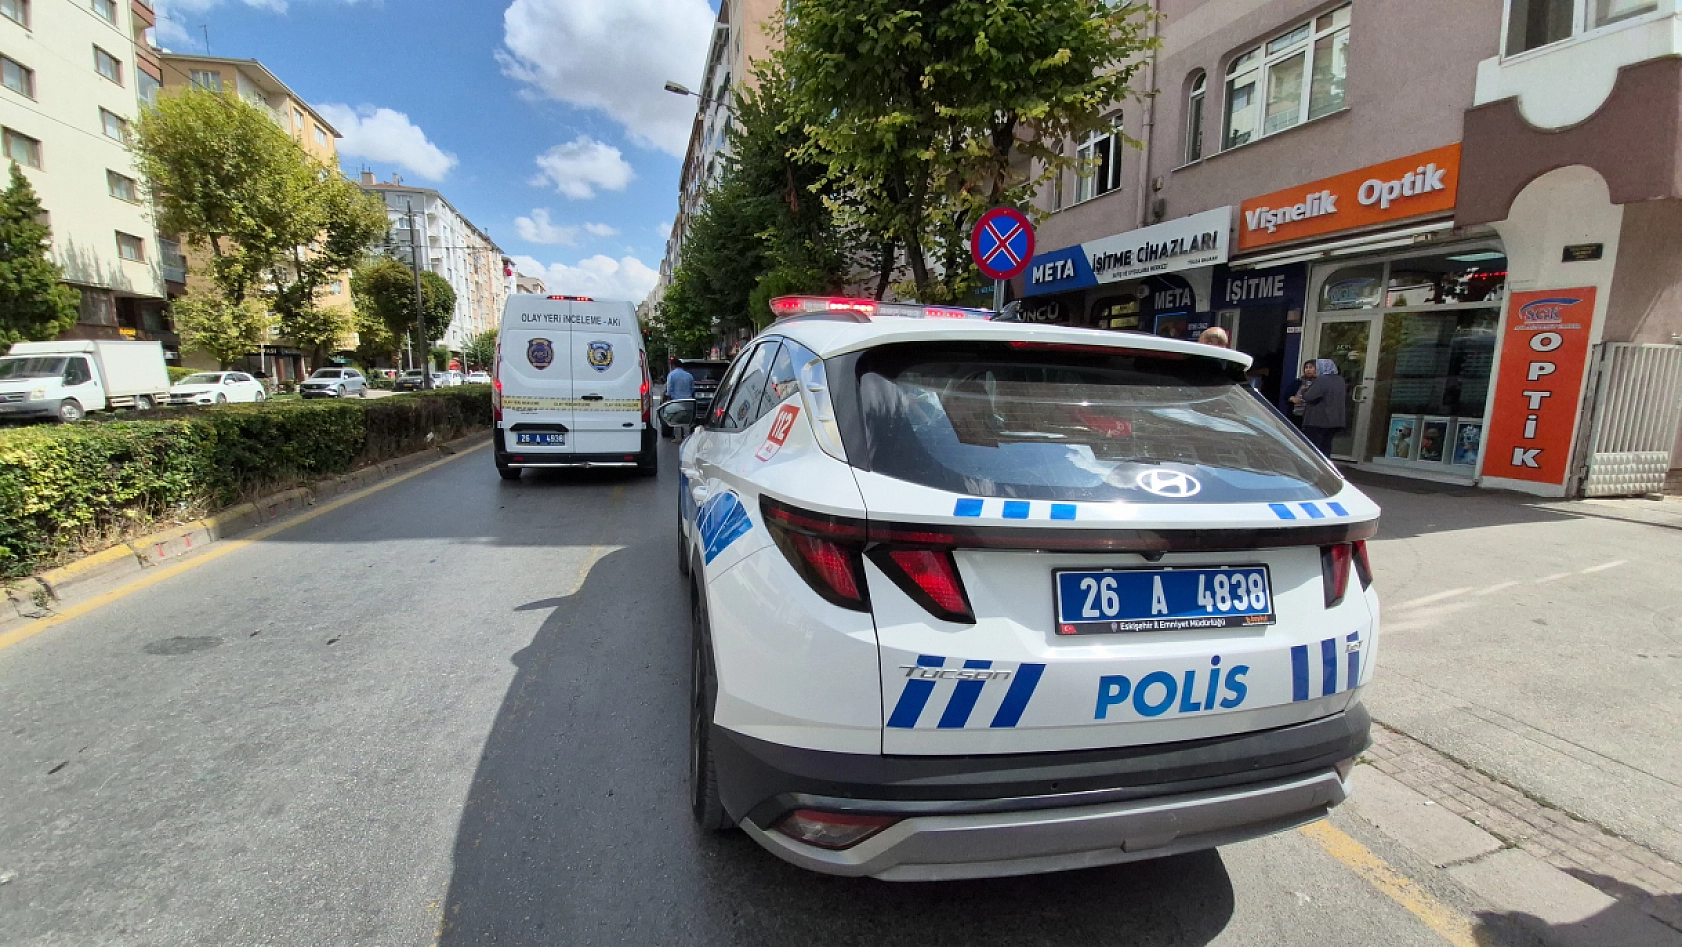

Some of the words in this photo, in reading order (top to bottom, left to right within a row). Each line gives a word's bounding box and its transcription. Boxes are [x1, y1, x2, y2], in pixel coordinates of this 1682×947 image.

[1245, 189, 1338, 233] Vişnelik
[1358, 163, 1447, 209] Optik
[1032, 258, 1075, 284] META
[1092, 251, 1132, 275] İŞİTME
[1137, 230, 1219, 263] CİHAZLARI
[1154, 287, 1192, 310] META
[1225, 274, 1285, 305] İŞİTME
[521, 312, 542, 323] OLAY
[521, 434, 530, 443] 26
[535, 434, 541, 443] A
[1079, 576, 1120, 618] 26
[1151, 575, 1168, 615] A
[1197, 572, 1266, 612] 4838
[1120, 621, 1153, 632] Eskişehir
[1160, 620, 1189, 631] Emniyet
[1190, 617, 1226, 628] Müdürlüğü
[1094, 654, 1250, 719] POLİS
